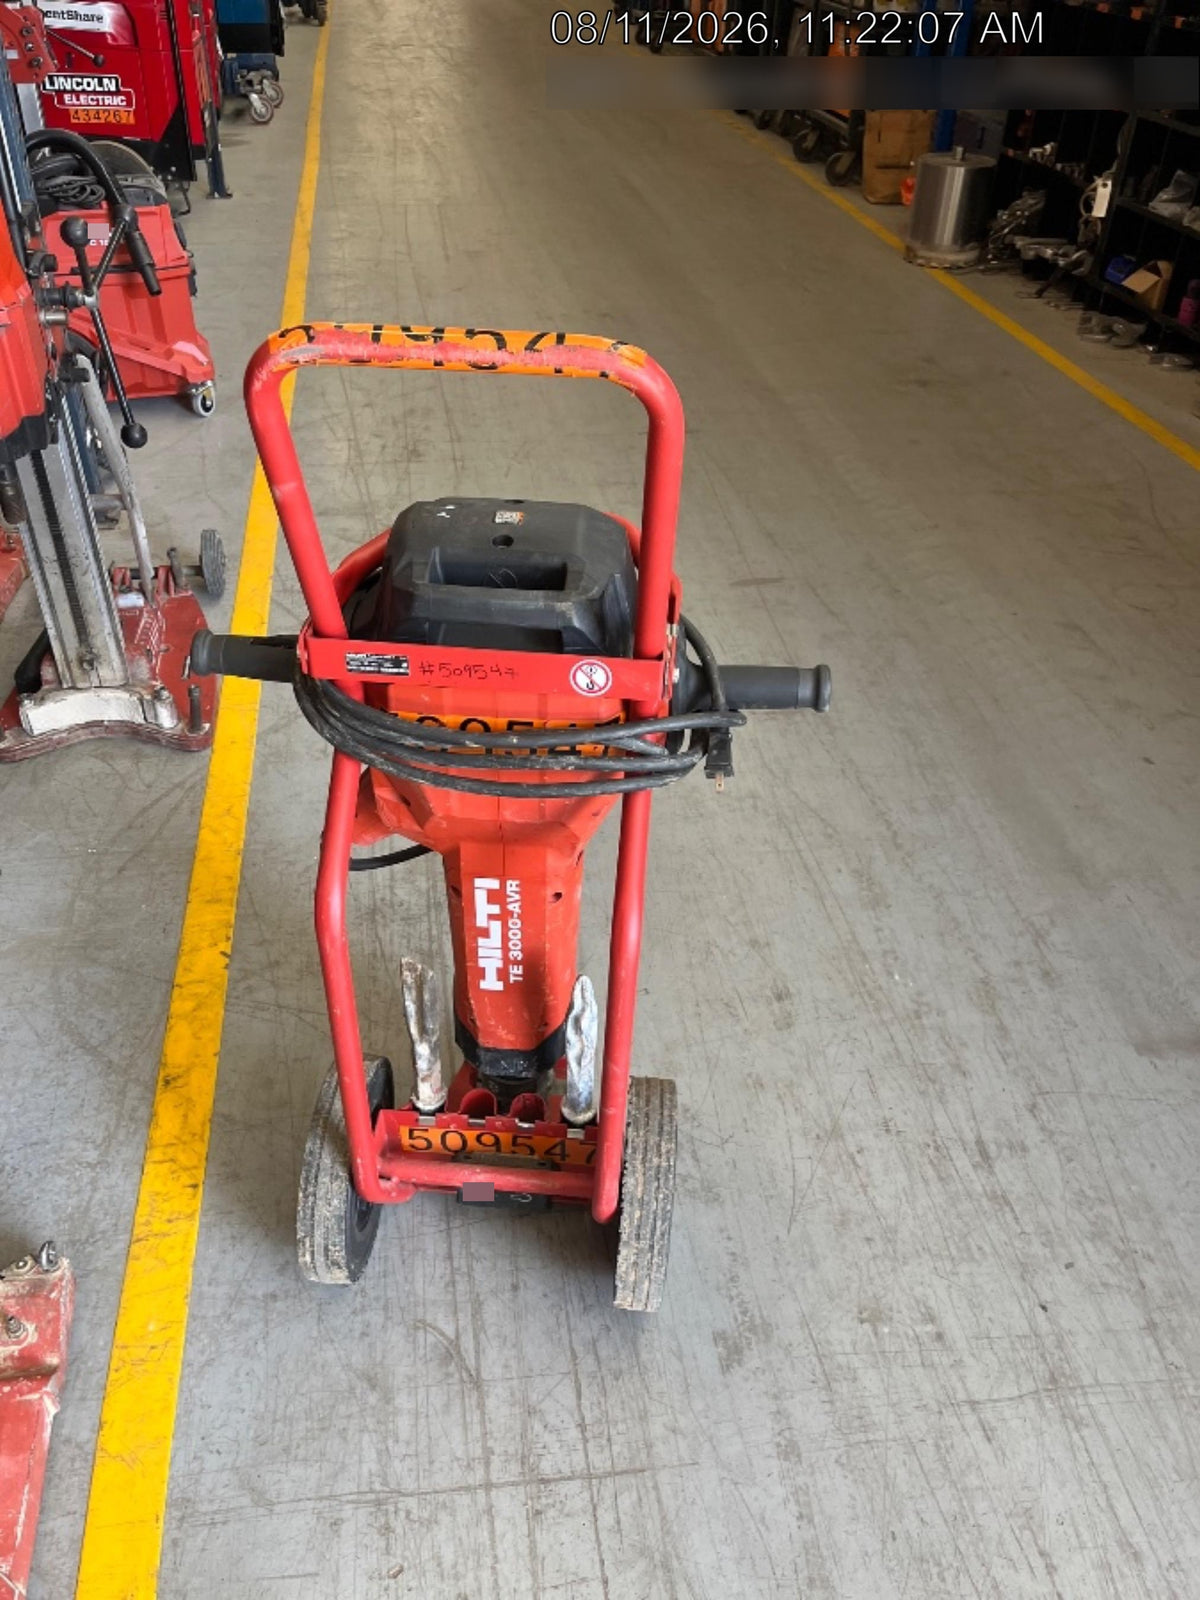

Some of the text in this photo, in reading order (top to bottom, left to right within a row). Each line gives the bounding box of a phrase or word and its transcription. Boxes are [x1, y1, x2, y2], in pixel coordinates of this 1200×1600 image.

[45, 76, 117, 91] LINCOLN
[63, 94, 127, 106] ELECTRIC
[419, 661, 517, 680] #509547
[474, 877, 504, 991] HILTI
[506, 879, 523, 983] TE 3000-AVR
